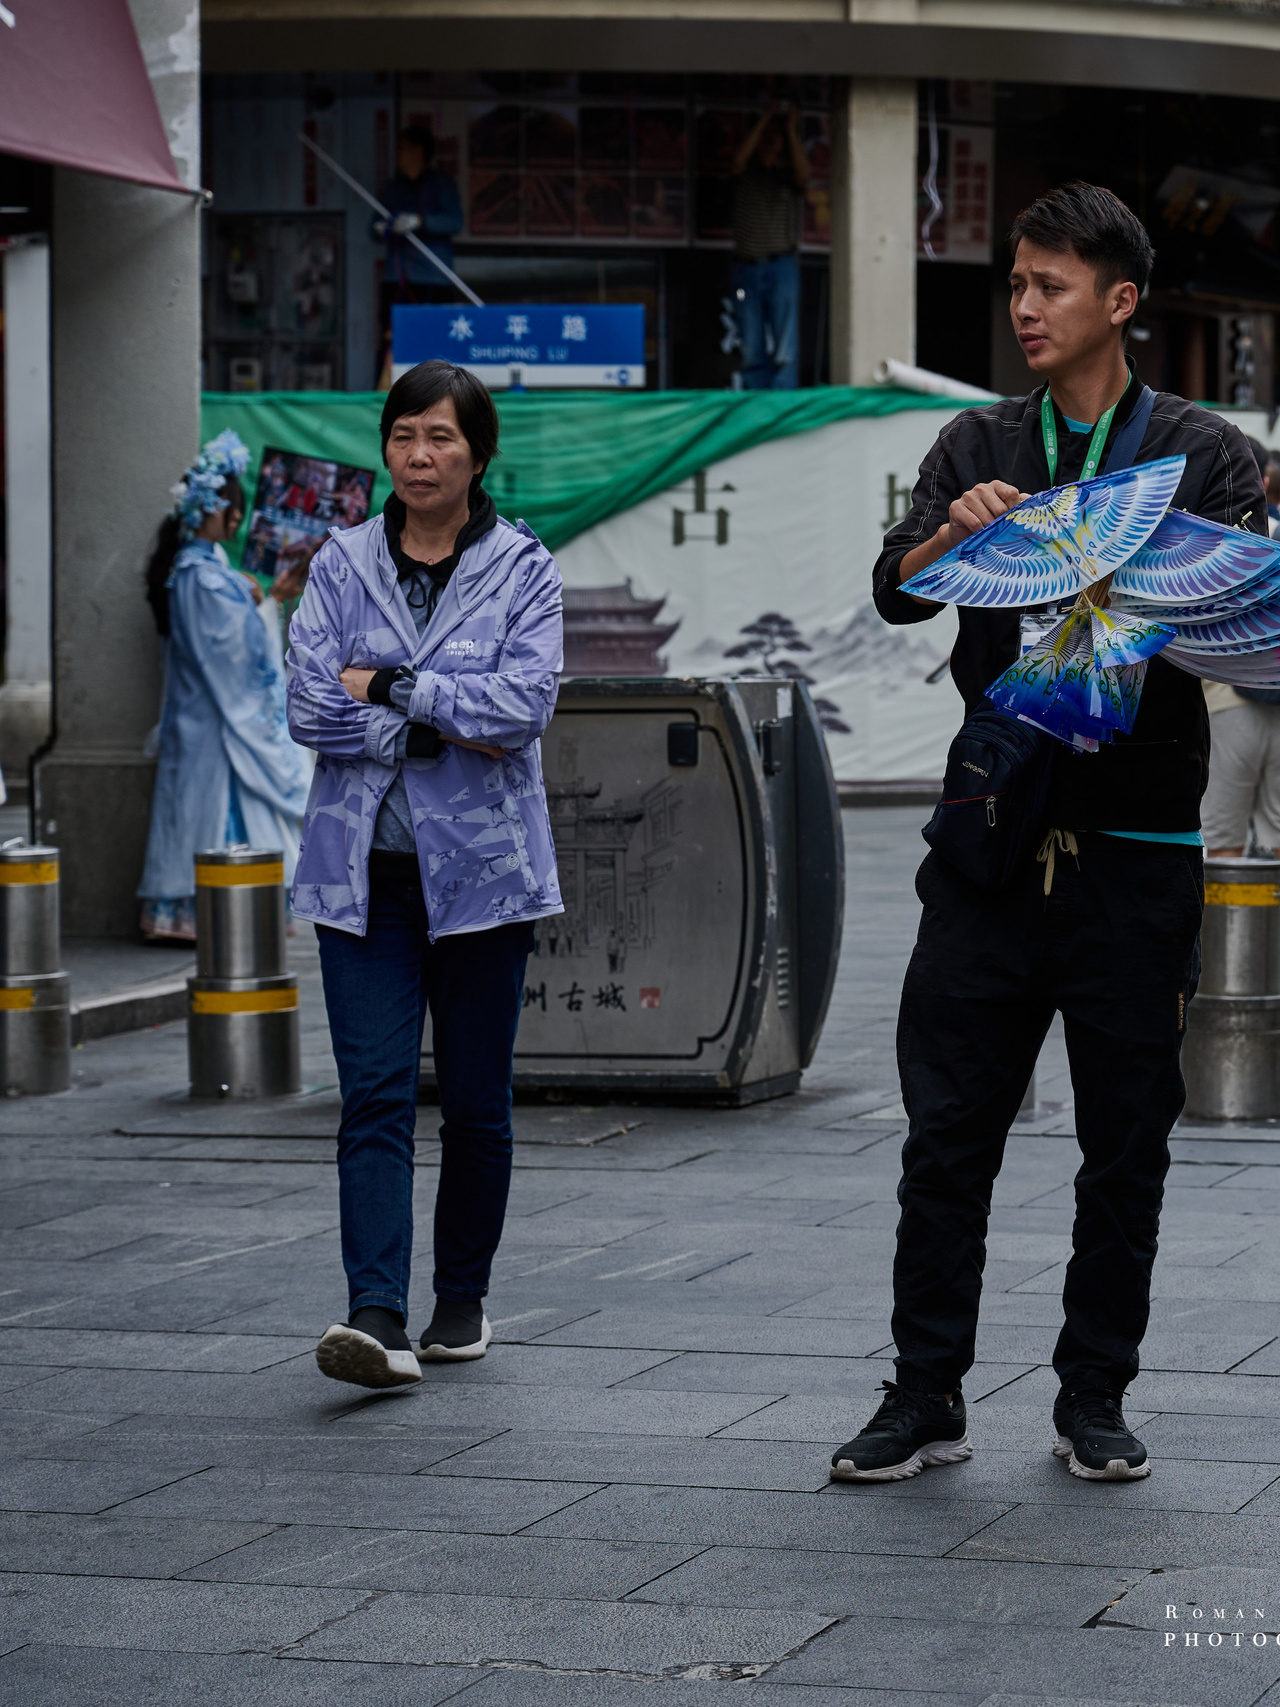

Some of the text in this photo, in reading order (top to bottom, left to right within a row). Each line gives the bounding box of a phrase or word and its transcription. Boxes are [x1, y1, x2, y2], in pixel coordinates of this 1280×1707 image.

[448, 315, 587, 341] 水平路
[547, 346, 568, 361] LU
[444, 639, 474, 650] Jeep
